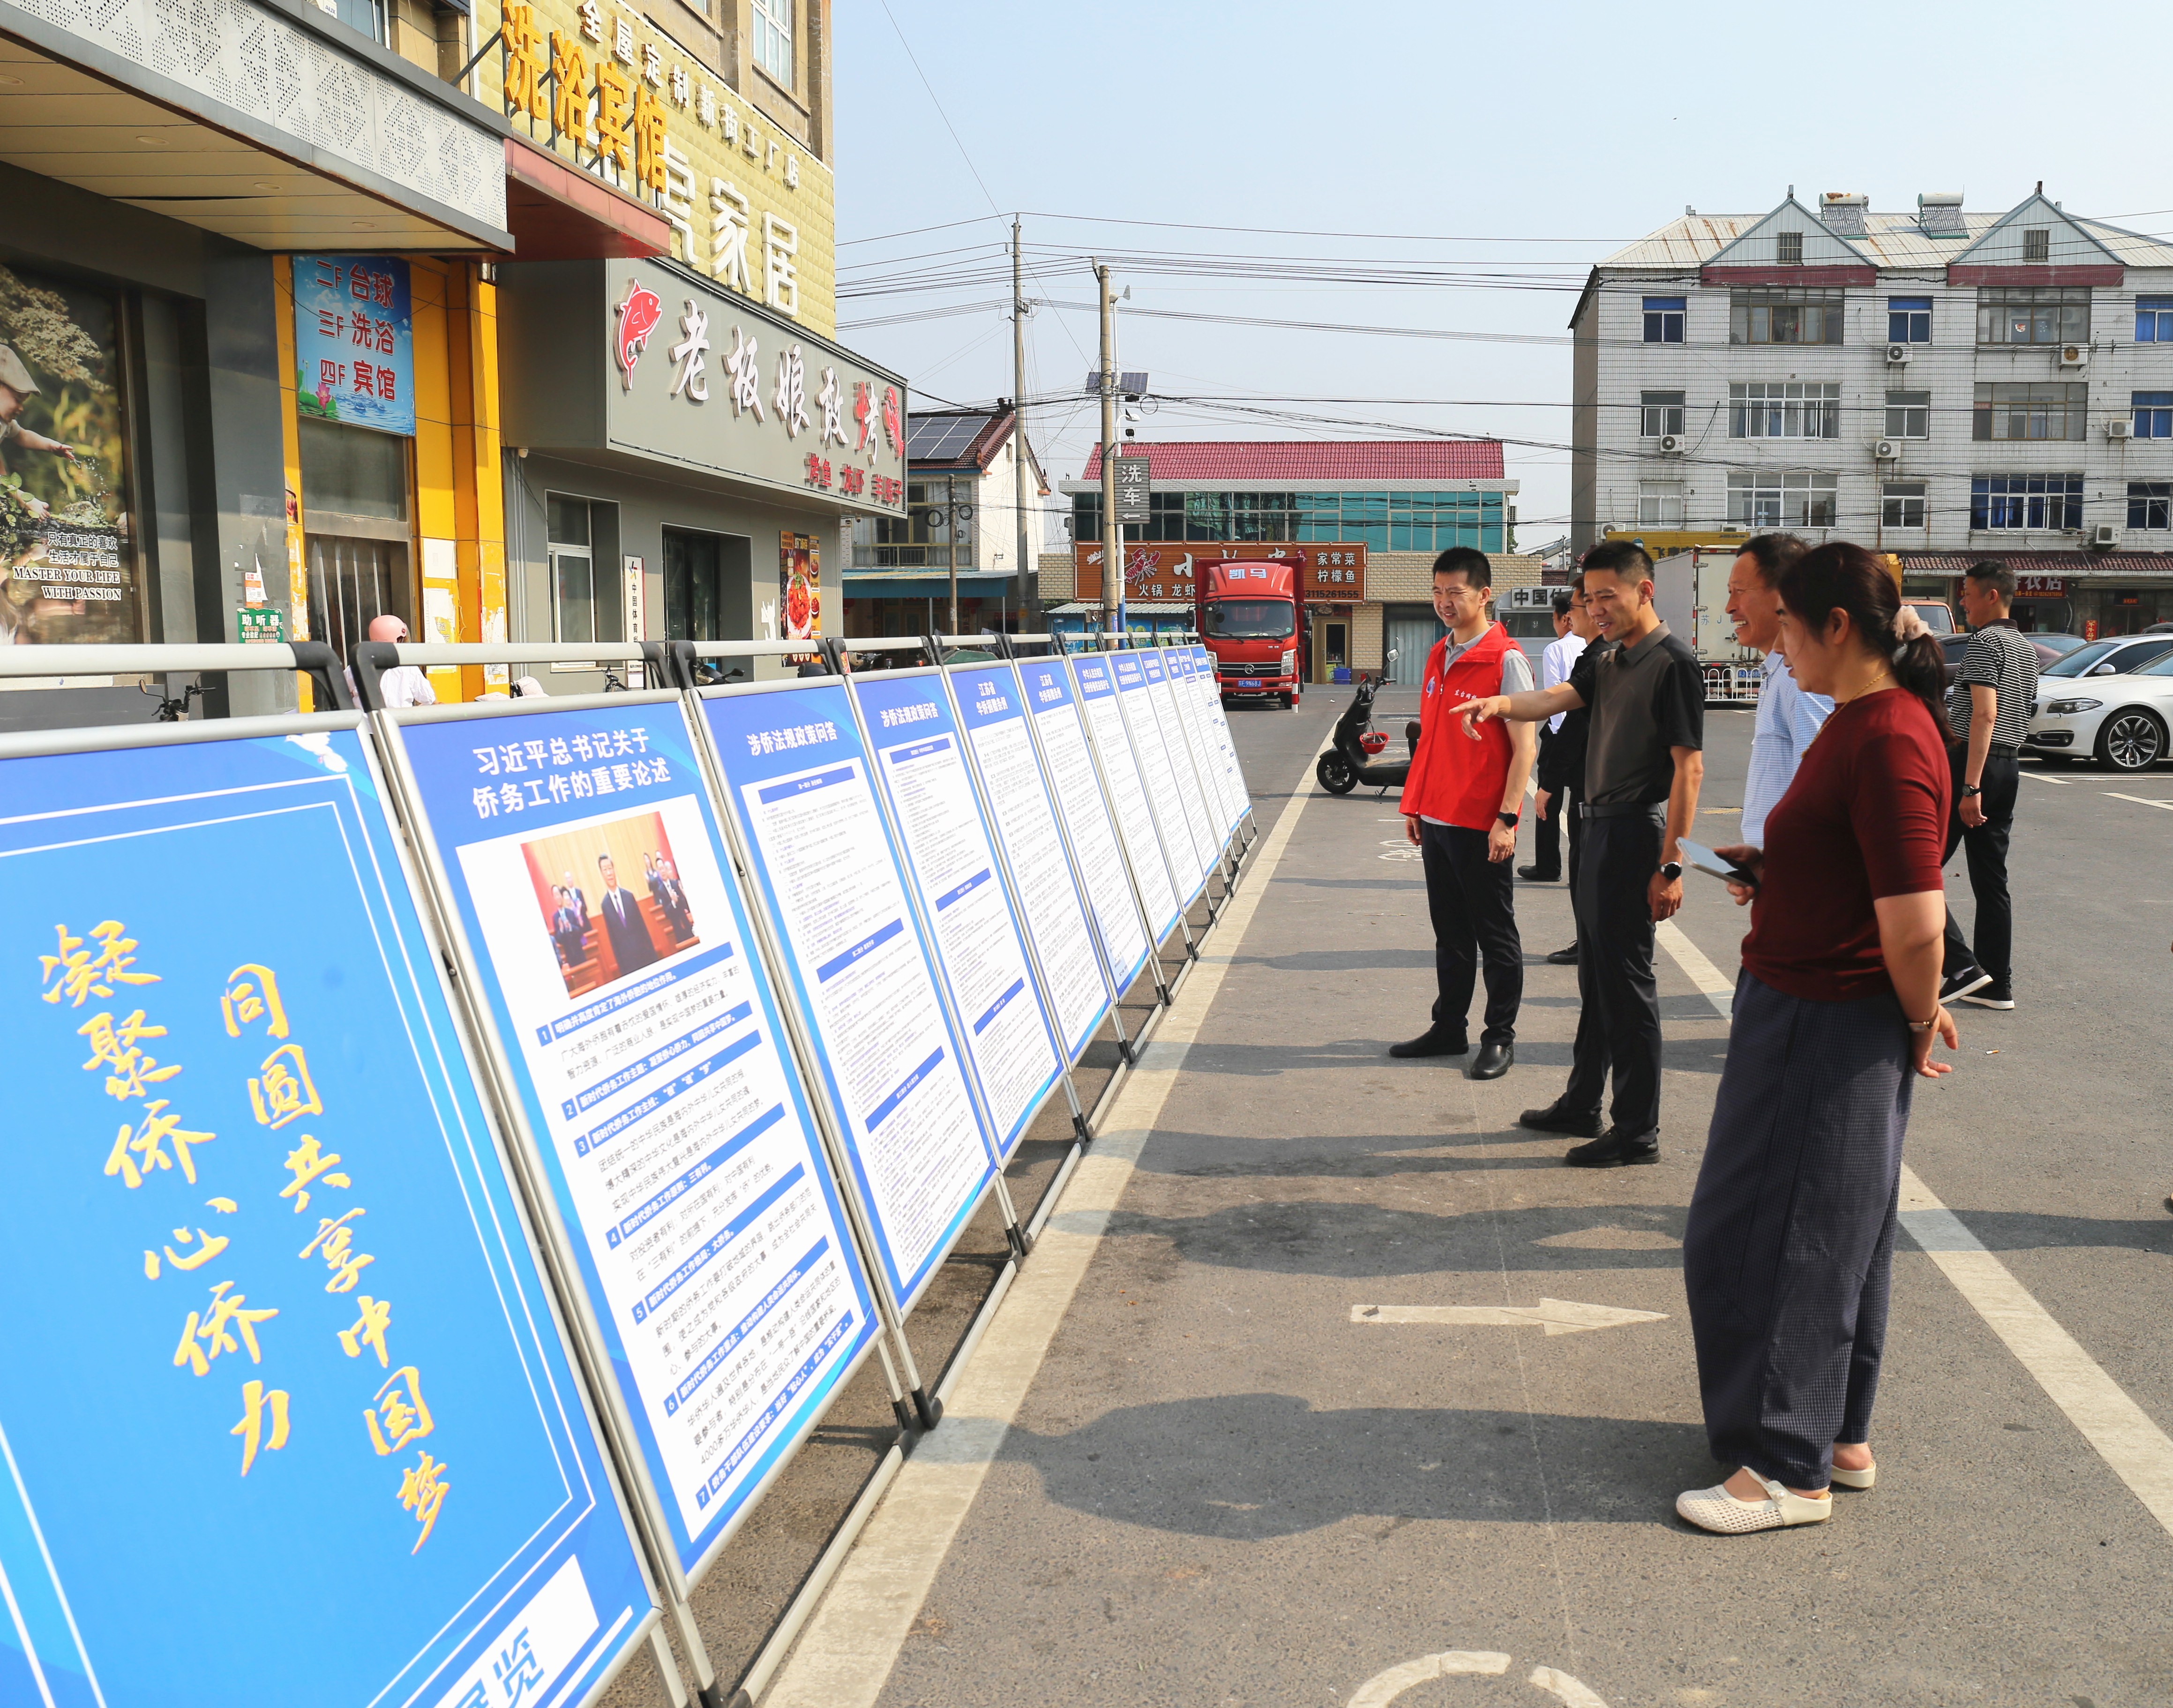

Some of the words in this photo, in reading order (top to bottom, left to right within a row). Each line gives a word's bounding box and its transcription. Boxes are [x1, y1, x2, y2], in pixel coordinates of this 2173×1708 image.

[325, 5, 336, 15] AUX
[502, 0, 667, 194] 洗浴宾馆
[578, 0, 799, 188] 全屋定制新街工厂店
[316, 260, 343, 290] 二F
[349, 263, 394, 308] 台球
[319, 309, 344, 337] 三F
[352, 311, 394, 355] 洗浴
[320, 358, 345, 386] 四F
[353, 360, 395, 401] 宾馆
[804, 452, 832, 487] 烤鱼
[840, 464, 864, 494] 龙虾
[1121, 464, 1142, 506] 洗车
[48, 532, 118, 550] 只有真正的喜欢
[48, 549, 119, 567] 生活才属于自己
[1317, 552, 1355, 566] 家常菜
[13, 567, 62, 581] MASTER
[63, 569, 93, 582] YOUR
[95, 570, 120, 583] LIFE
[1229, 568, 1266, 579] 凯马
[1317, 569, 1355, 583] 柠檬鱼
[41, 586, 74, 599] WITH
[75, 587, 121, 600] PASSION
[1139, 583, 1162, 597] 火锅
[1172, 583, 1195, 597] 龙虾
[1304, 590, 1358, 598] 3115261555
[241, 614, 279, 626] 助听器
[978, 681, 996, 696] 江苏省
[1039, 673, 1053, 687] 江苏省
[880, 702, 939, 728] 涉侨法规政策问答
[746, 721, 837, 756] 涉侨法规政策问答
[473, 727, 649, 776] 习近平总书记关于
[472, 757, 671, 820] 侨务工作的重要论述
[38, 920, 289, 1477] 凝聚侨心侨力
[221, 962, 450, 1556] 同圆共享中国梦
